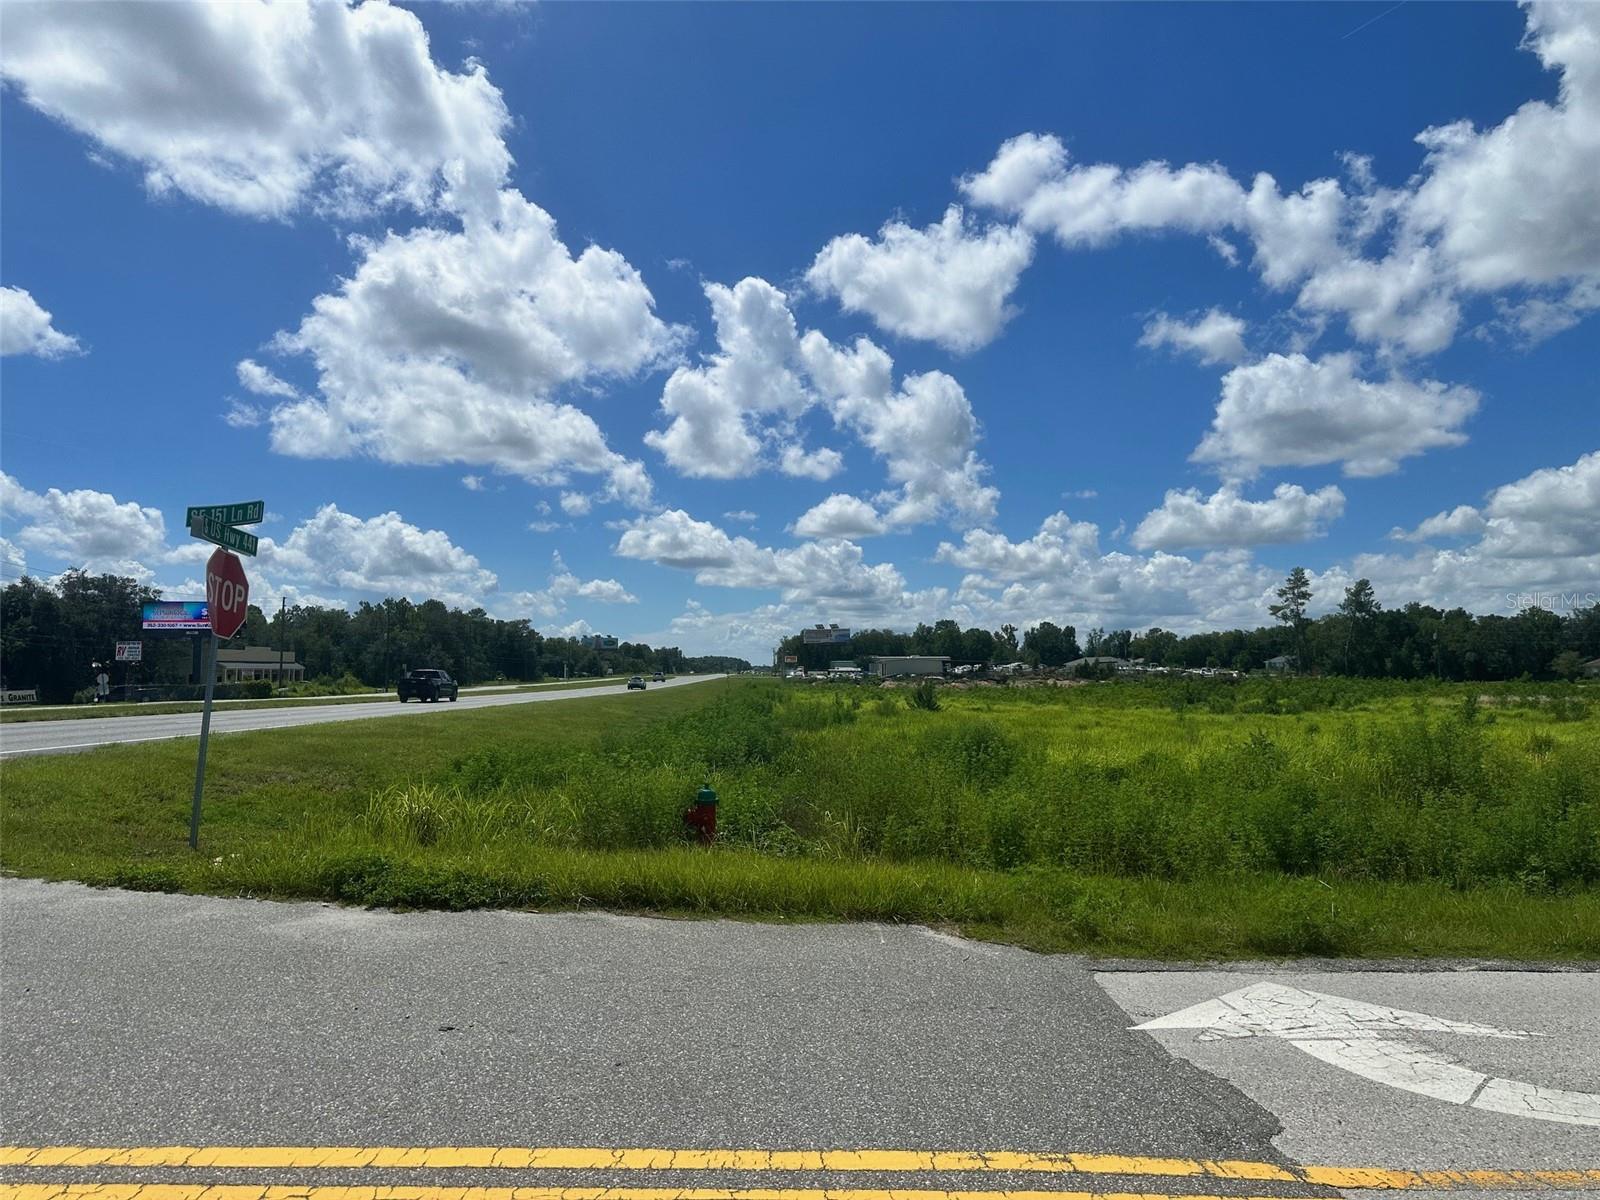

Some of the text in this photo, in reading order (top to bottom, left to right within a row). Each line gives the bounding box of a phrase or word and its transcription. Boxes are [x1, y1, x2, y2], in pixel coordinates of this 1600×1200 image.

[211, 507, 226, 523] 151
[231, 506, 243, 522] Ln
[247, 503, 259, 520] Rd
[210, 521, 222, 539] US
[223, 526, 241, 548] Hwy
[243, 534, 256, 552] 441
[207, 571, 246, 614] STOP
